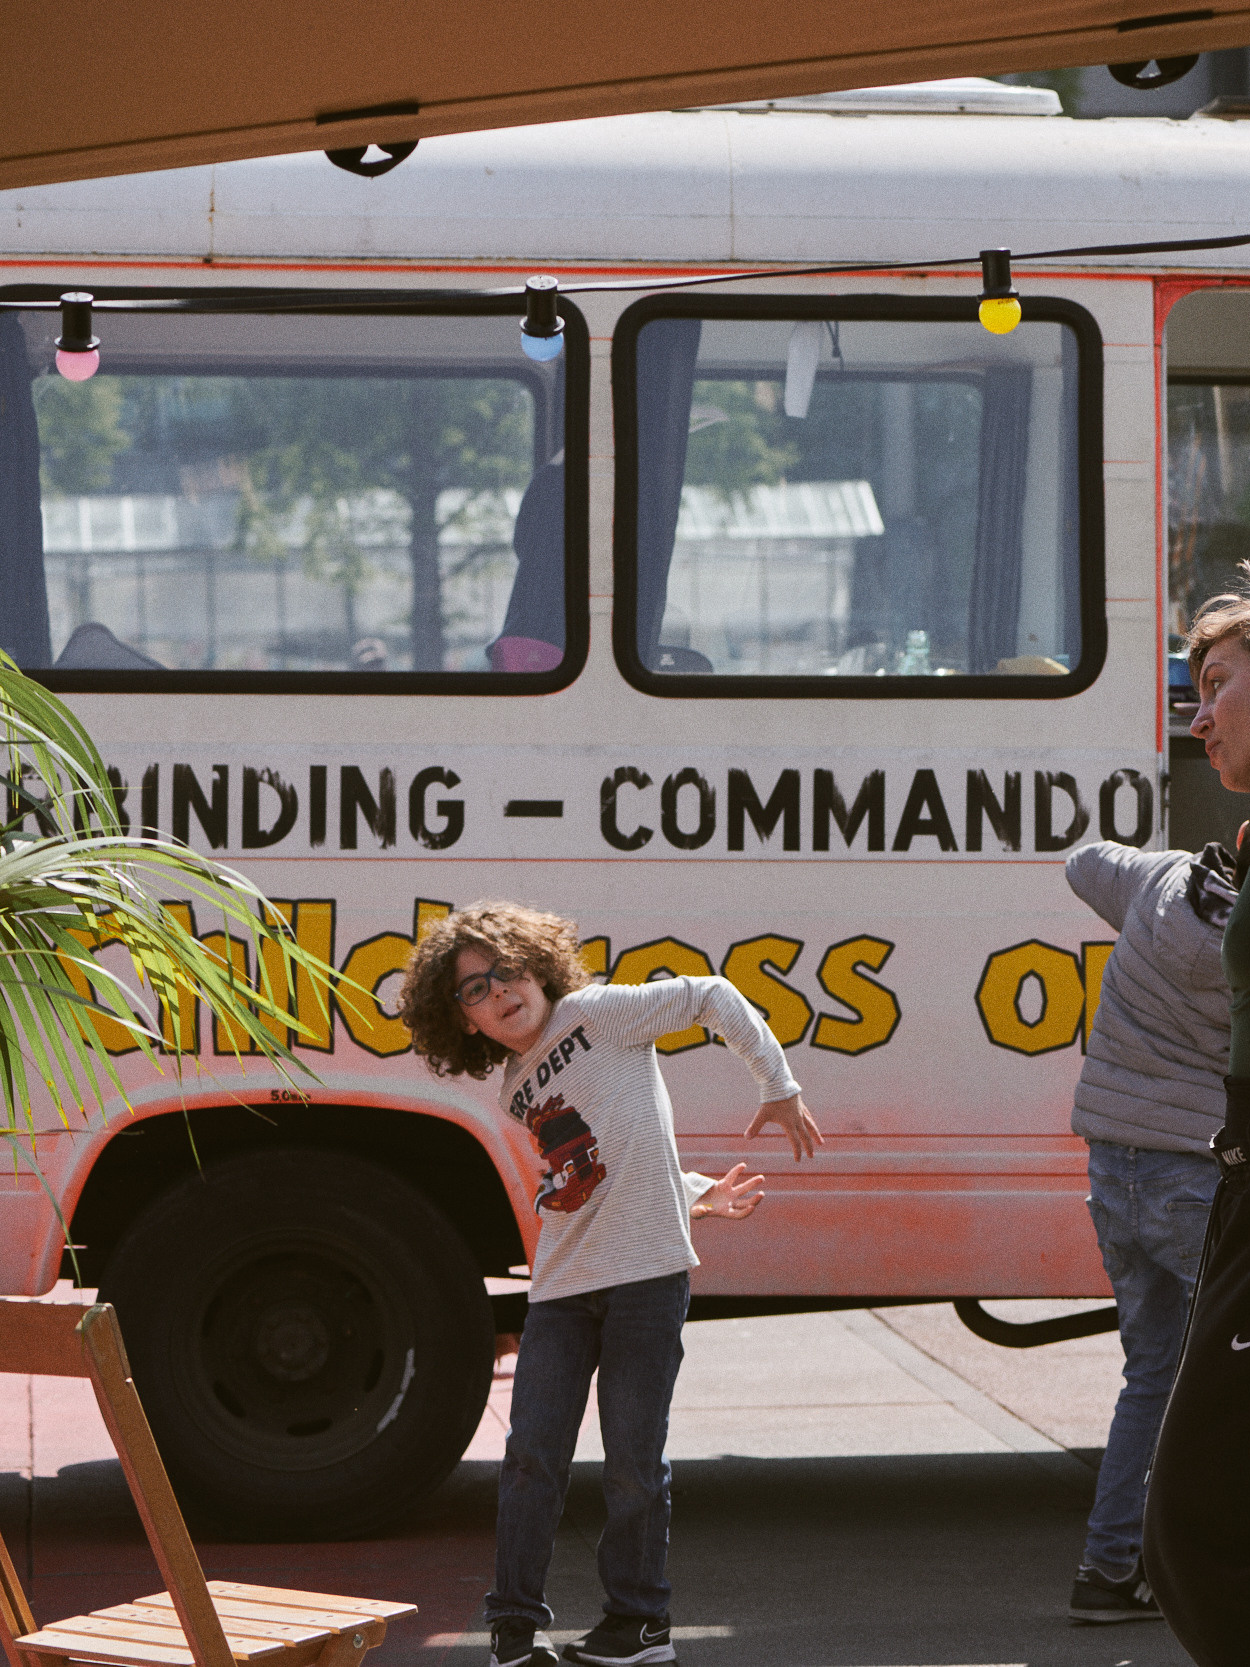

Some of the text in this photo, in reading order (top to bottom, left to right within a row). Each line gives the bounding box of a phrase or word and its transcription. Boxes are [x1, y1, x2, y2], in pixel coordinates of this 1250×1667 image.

[599, 766, 1154, 853] COMMANDO
[536, 1024, 593, 1090] DEPT
[1221, 1146, 1247, 1166] NIKE
